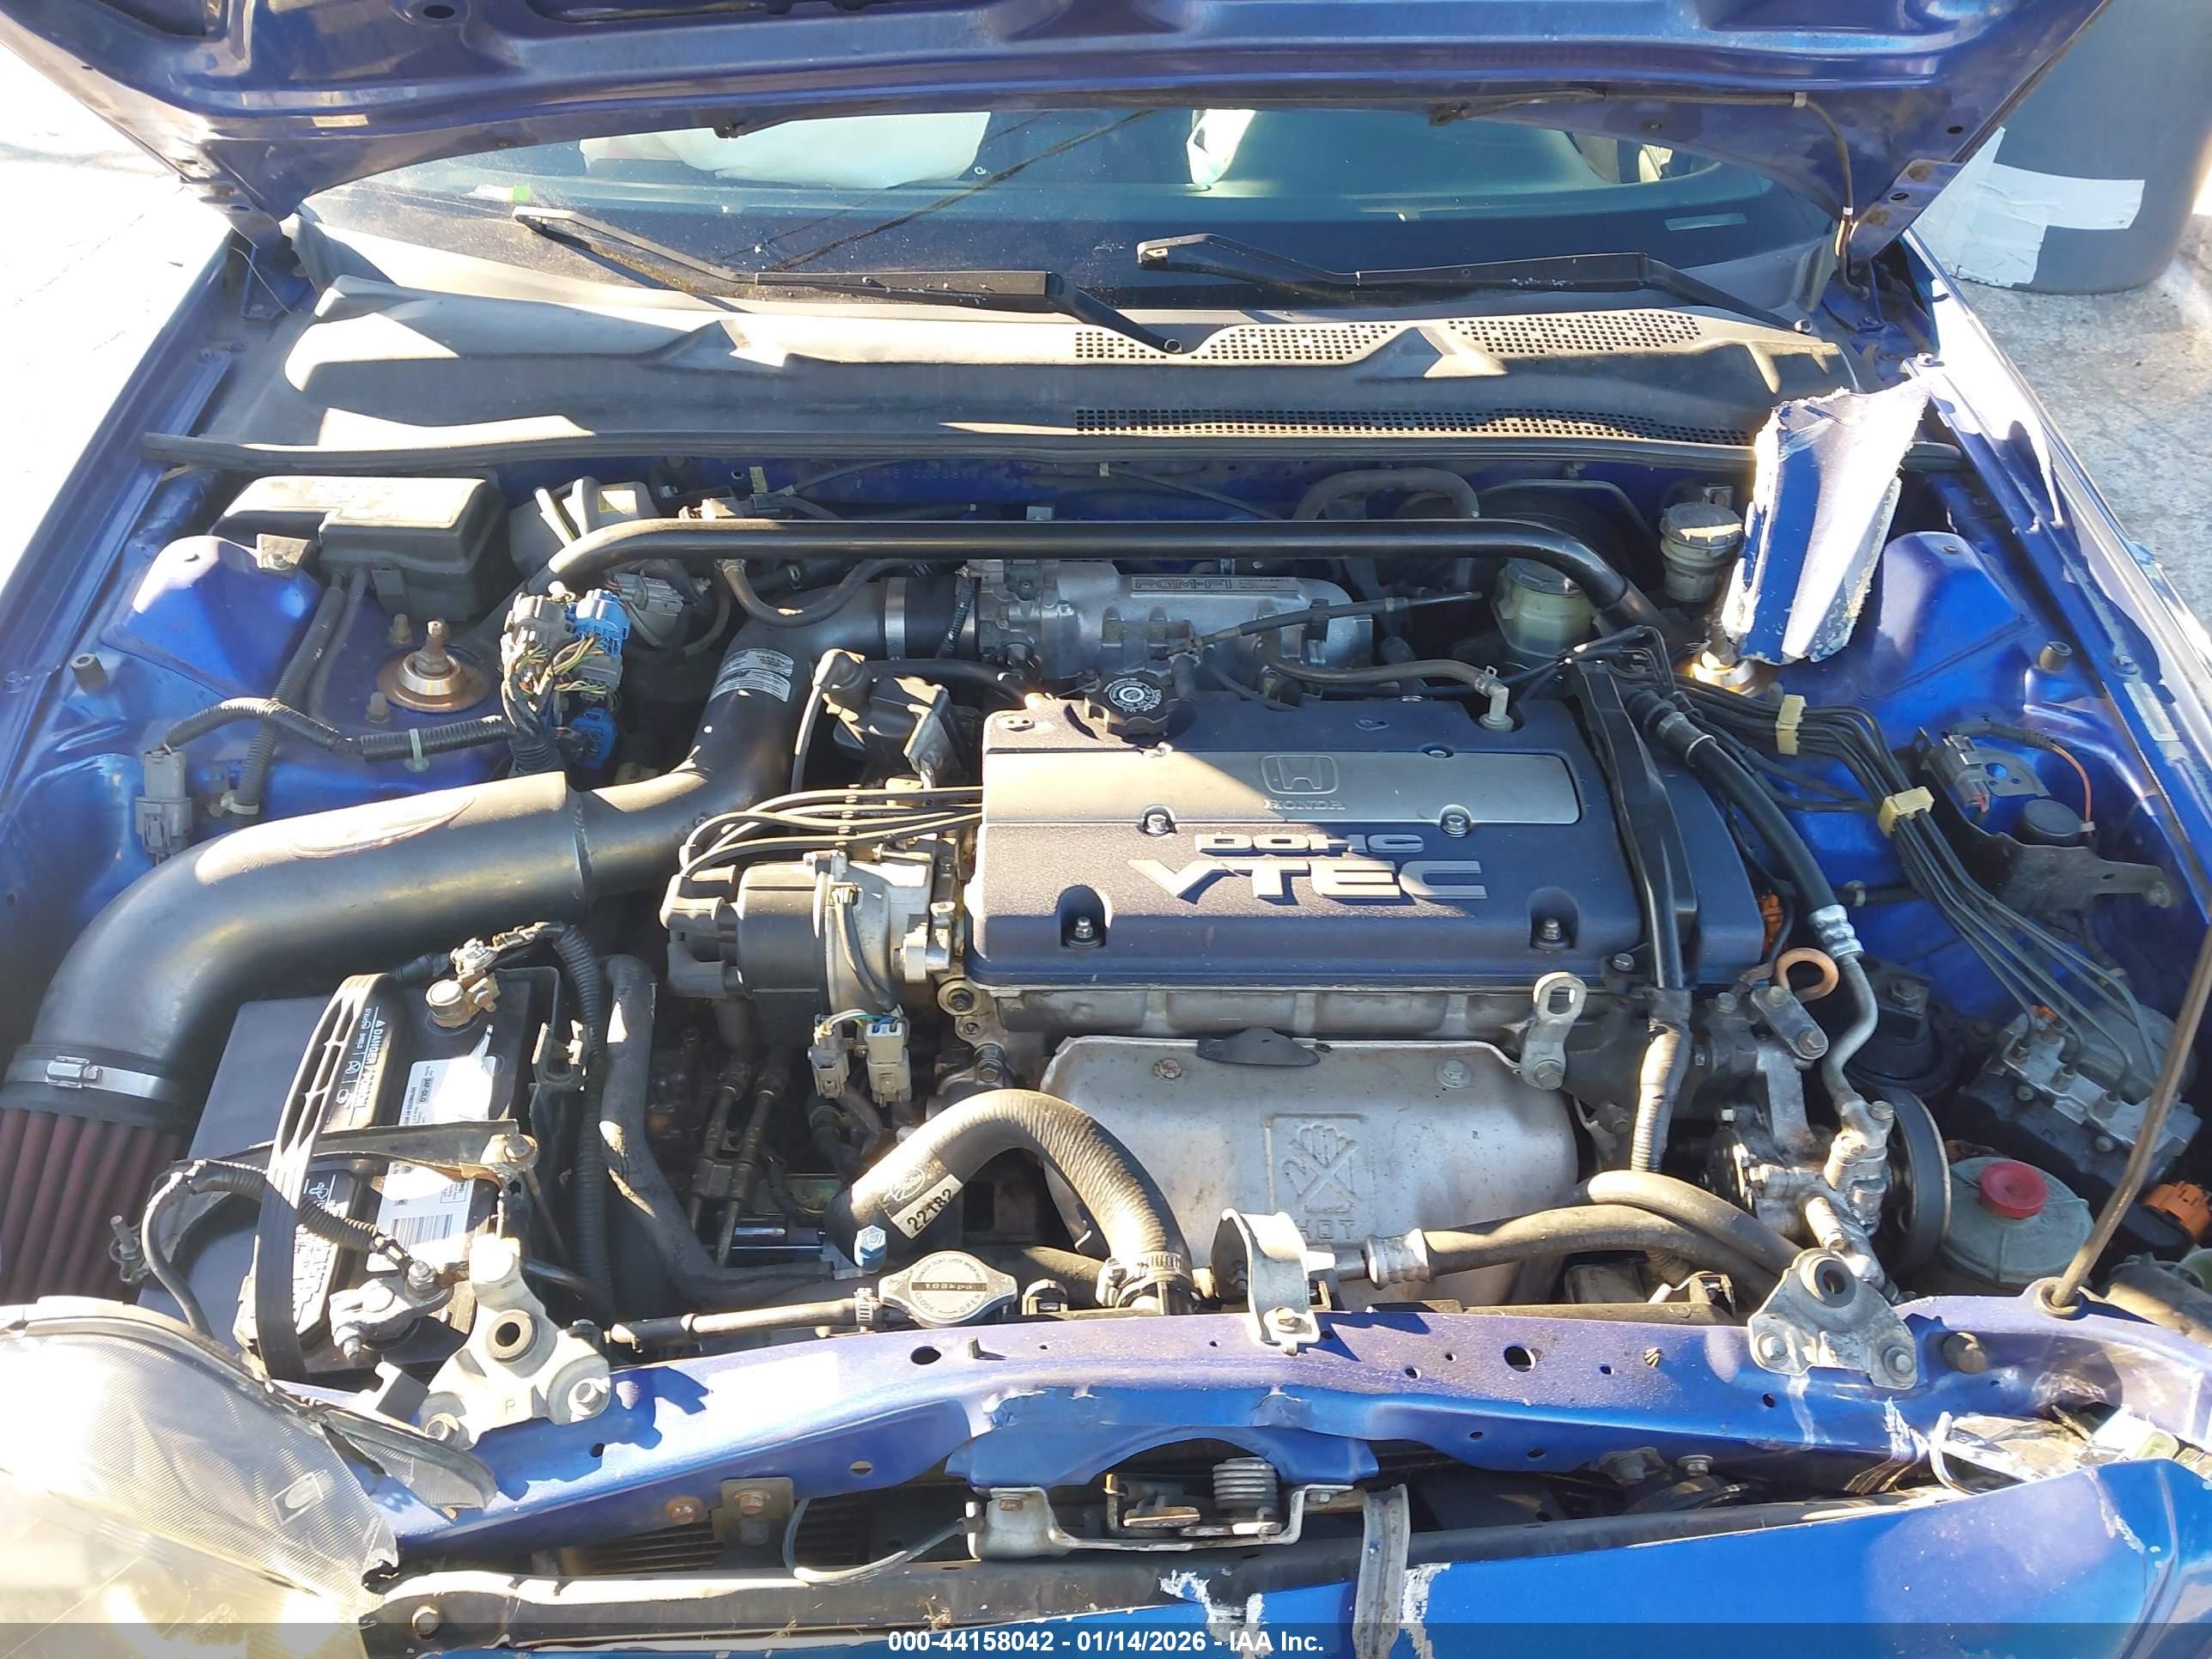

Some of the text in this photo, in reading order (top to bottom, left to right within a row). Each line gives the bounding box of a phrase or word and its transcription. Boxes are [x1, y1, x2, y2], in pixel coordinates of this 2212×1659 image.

[1134, 578, 1232, 590] PGM-FI
[1264, 799, 1346, 810] HONDA
[1194, 834, 1425, 854] DOHC
[1127, 860, 1488, 900] VTEC
[366, 1029, 384, 1065] DANGER
[907, 1188, 952, 1231] 22182
[1294, 1219, 1354, 1240] HOT
[915, 1291, 936, 1313] CLOSE
[959, 1293, 981, 1313] OPEN
